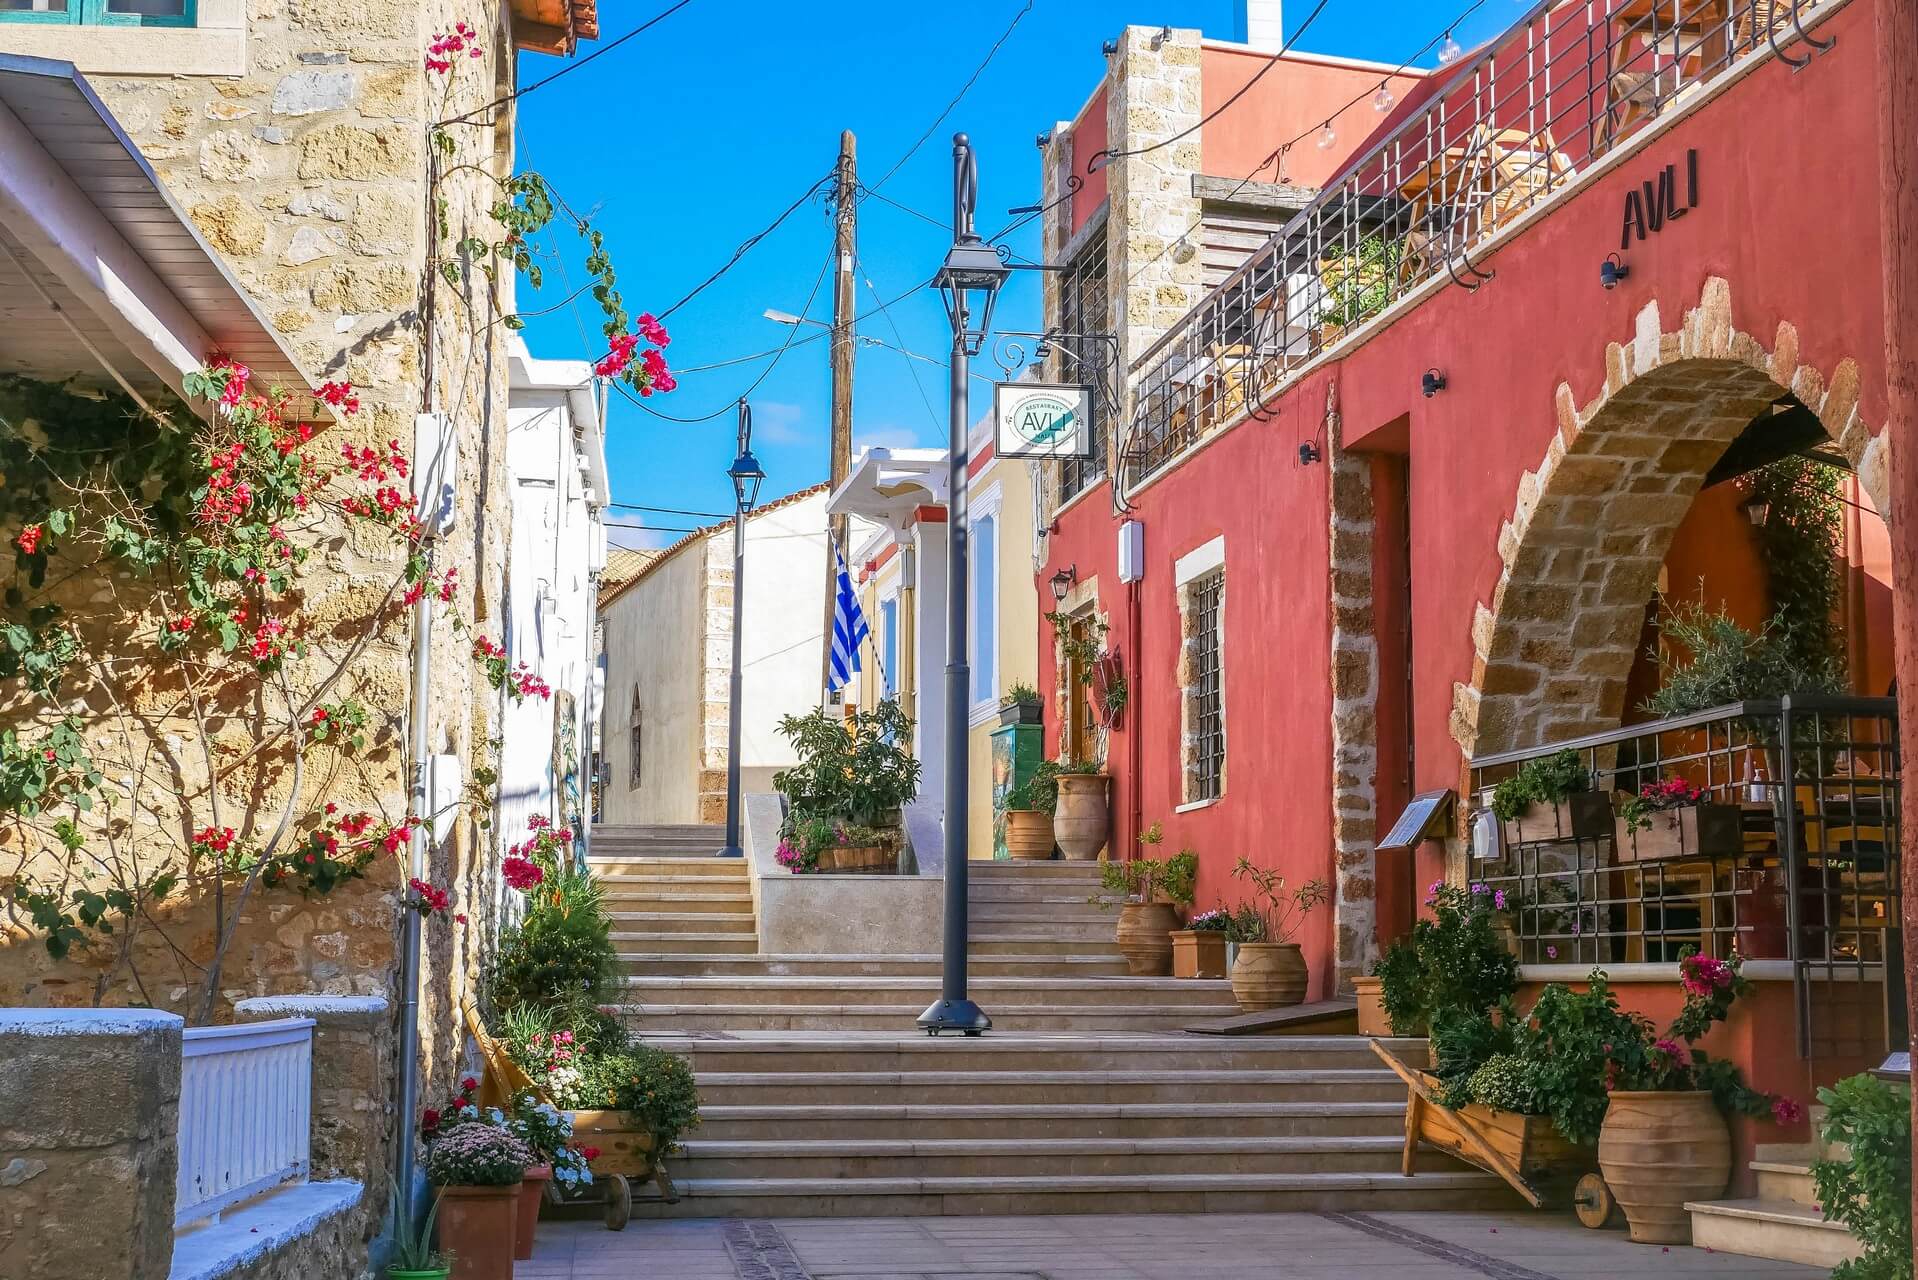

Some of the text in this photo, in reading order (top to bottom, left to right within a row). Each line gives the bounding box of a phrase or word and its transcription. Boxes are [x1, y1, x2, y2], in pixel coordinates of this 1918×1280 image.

[1622, 149, 1698, 250] AVLI
[1026, 403, 1063, 412] RESTAURANT
[1021, 412, 1067, 432] AVLI
